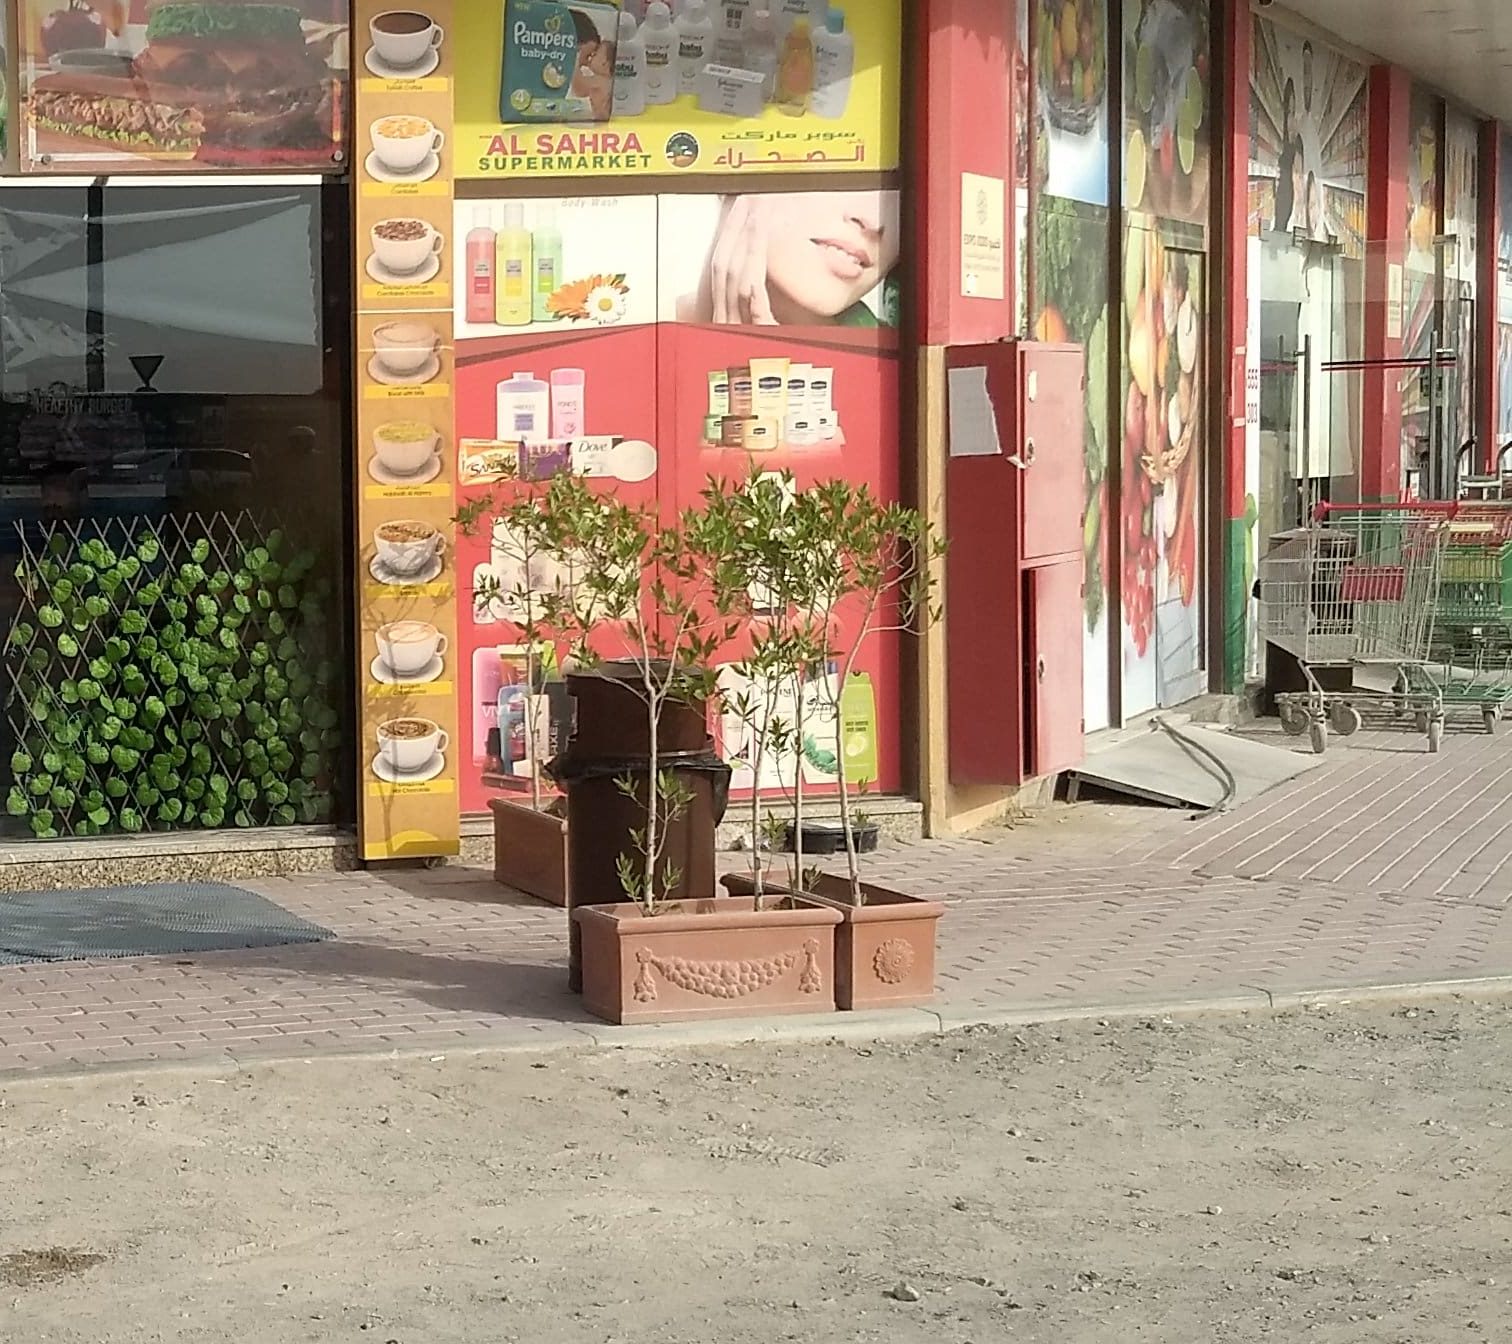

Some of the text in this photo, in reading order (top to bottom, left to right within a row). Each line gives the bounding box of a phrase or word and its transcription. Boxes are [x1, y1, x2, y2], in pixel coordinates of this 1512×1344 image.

[513, 20, 575, 49] Pampers
[487, 134, 528, 155] AL
[535, 132, 643, 155] SAHRA
[479, 154, 652, 170] SUPERMARKET
[713, 144, 865, 169] الصحراء
[578, 440, 609, 454] Dove
